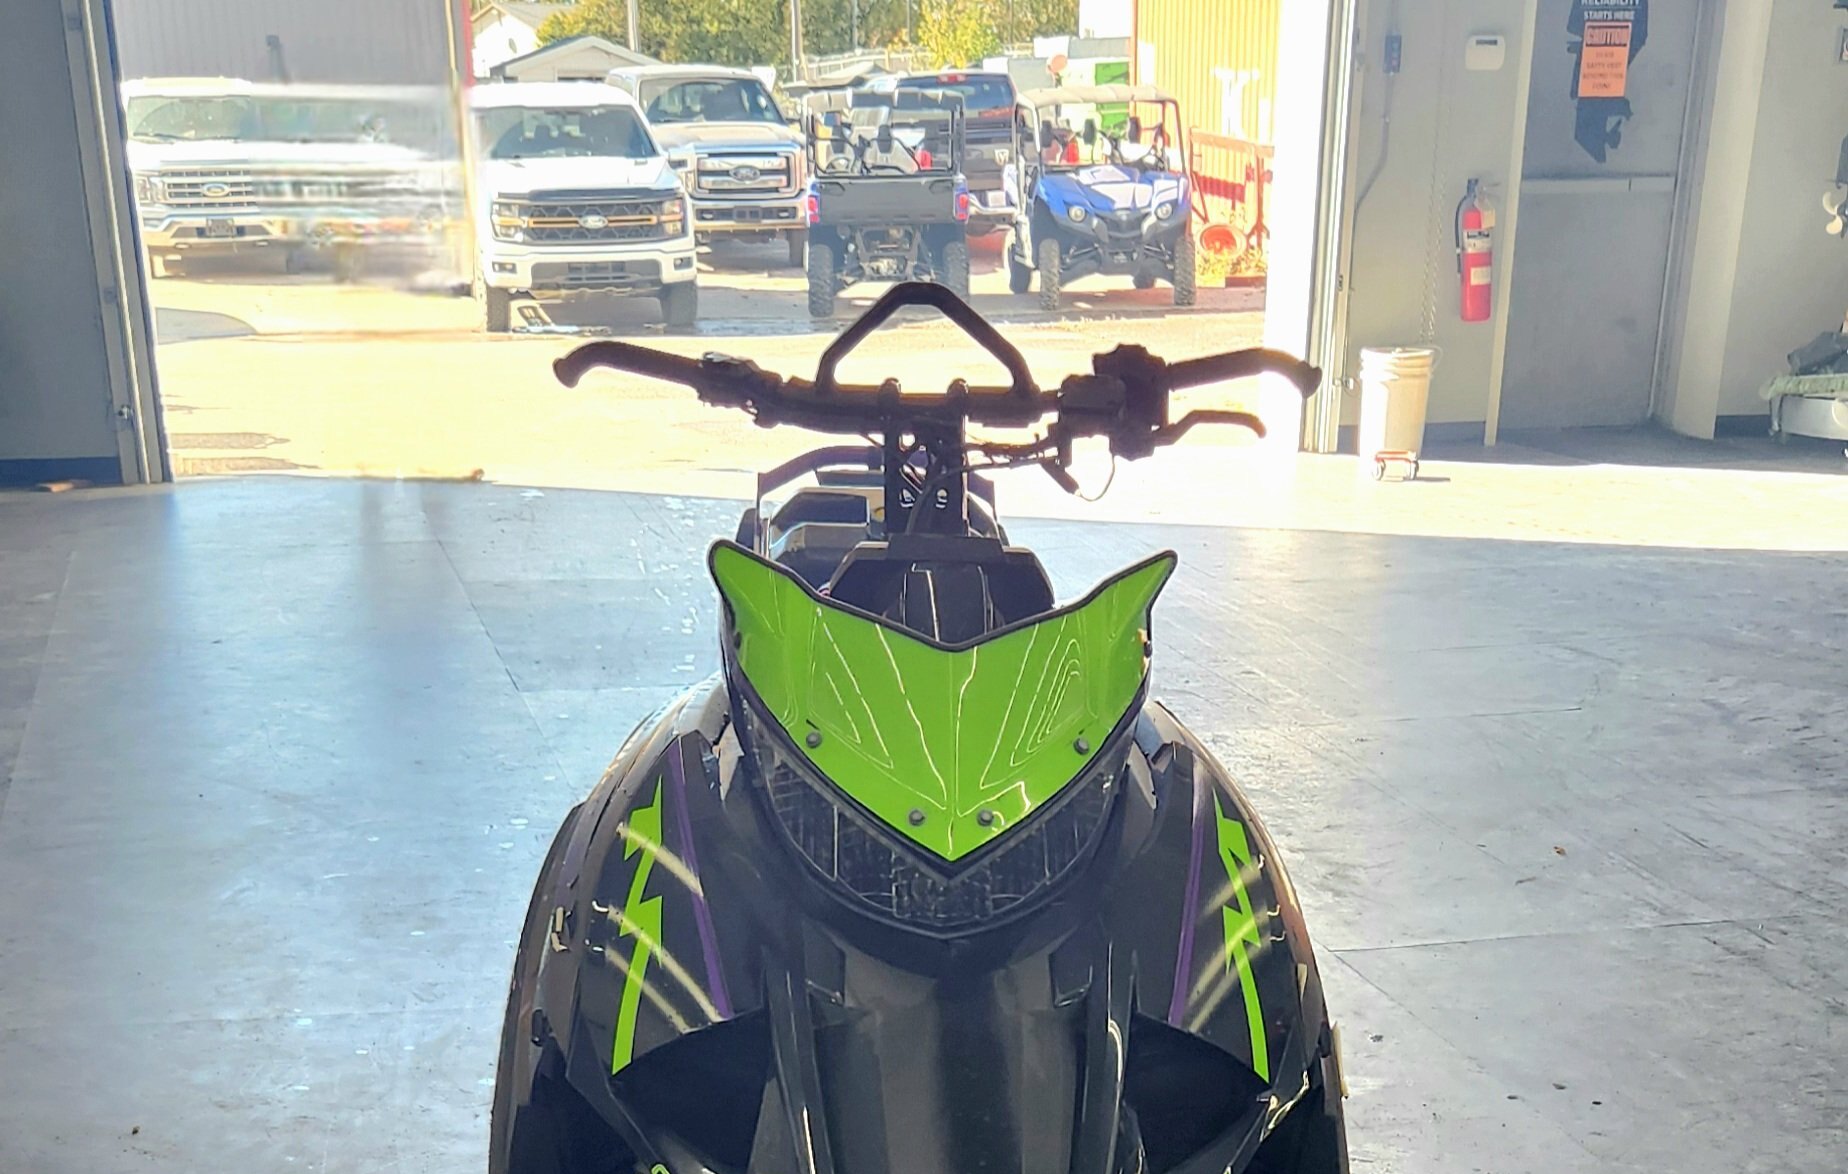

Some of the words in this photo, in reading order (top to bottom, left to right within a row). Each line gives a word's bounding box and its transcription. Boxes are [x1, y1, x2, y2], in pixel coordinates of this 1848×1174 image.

[1583, 10, 1613, 20] STARTS
[1613, 10, 1635, 20] HERE
[1586, 28, 1629, 45] CAUTION
